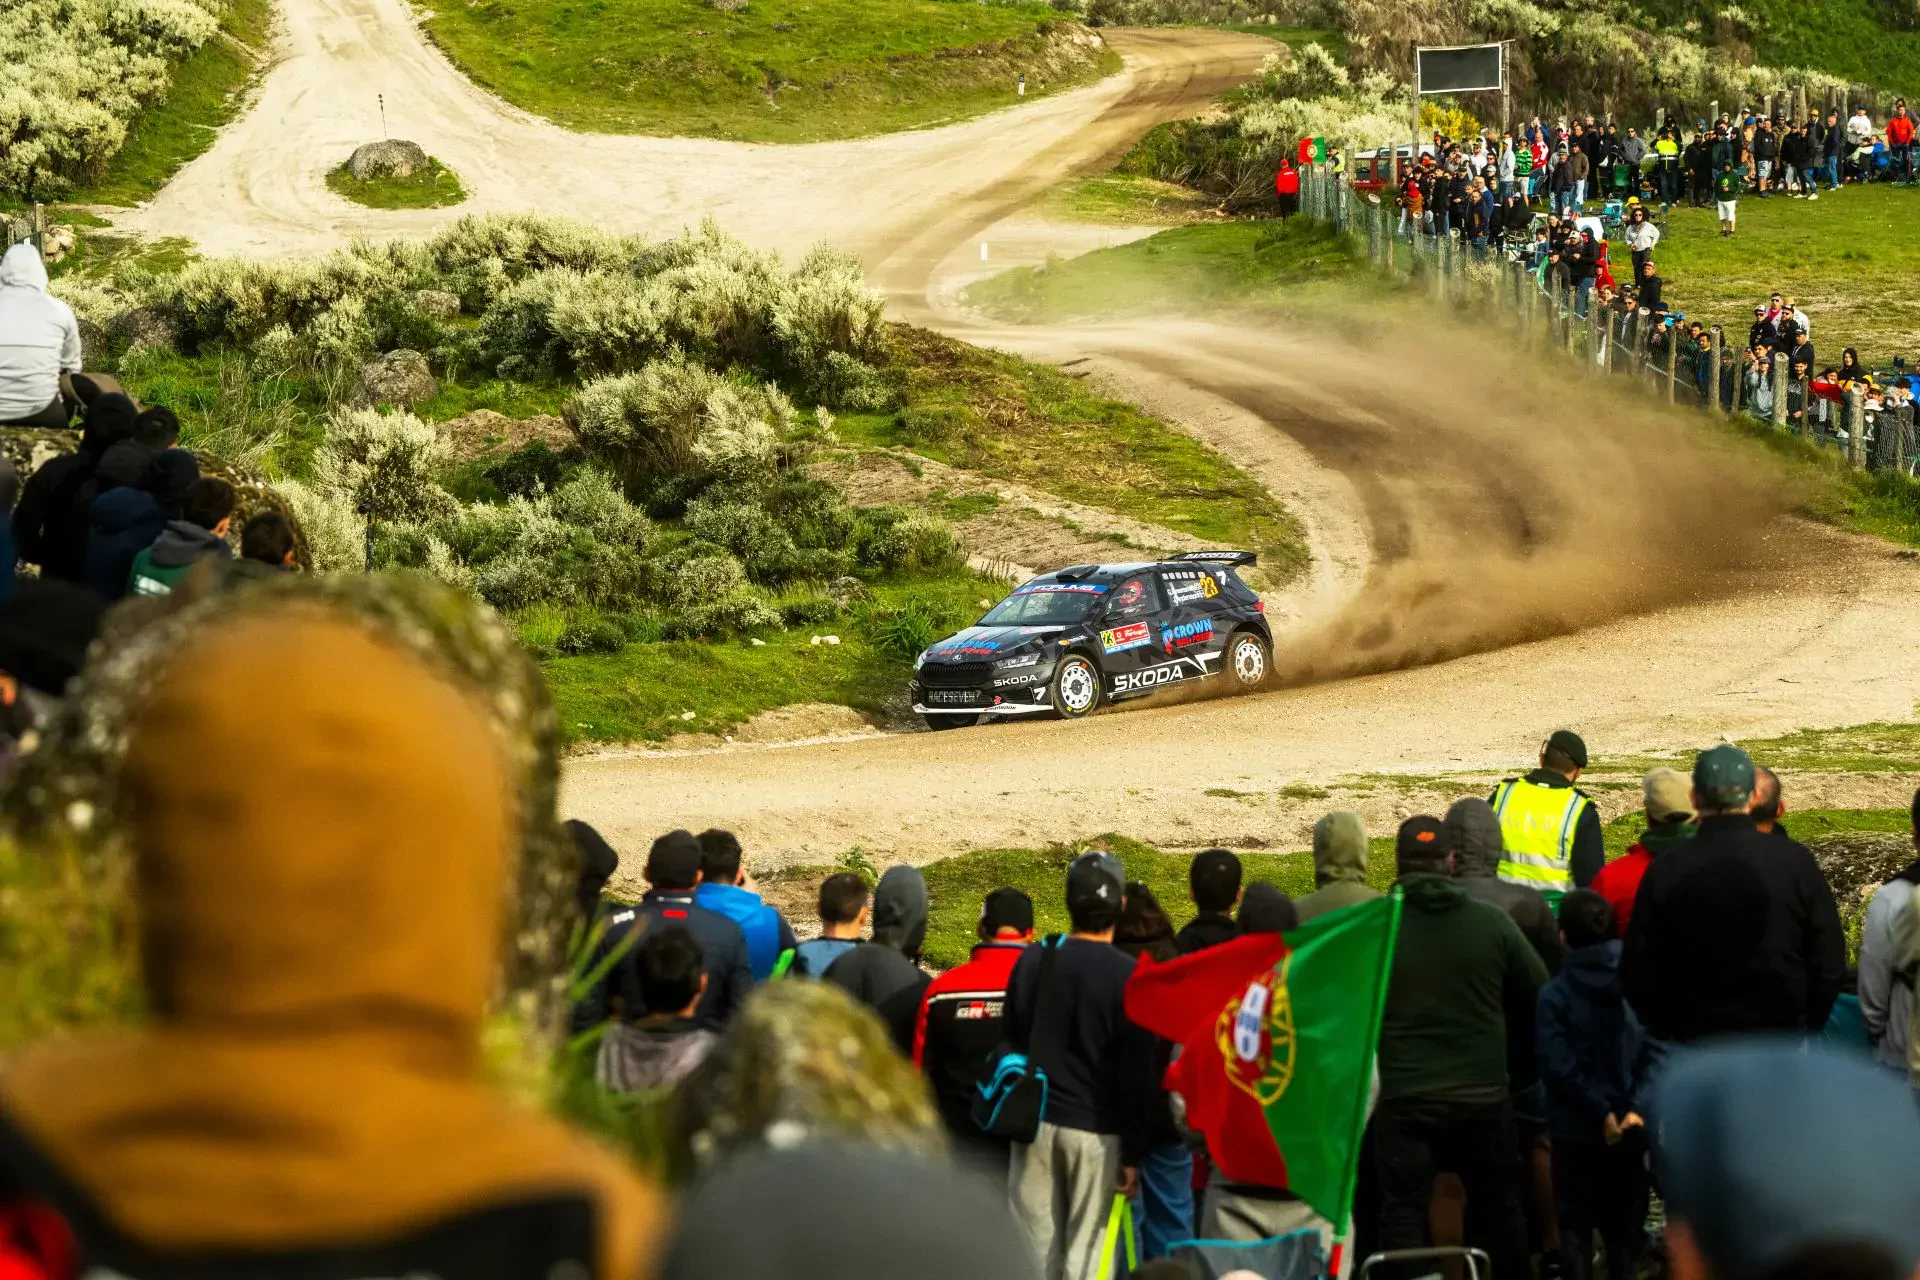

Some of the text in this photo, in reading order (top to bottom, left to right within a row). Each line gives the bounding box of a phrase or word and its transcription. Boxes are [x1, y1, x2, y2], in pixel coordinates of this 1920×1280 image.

[1199, 576, 1219, 598] 23
[1173, 618, 1213, 639] CROWN
[1101, 630, 1115, 647] 23
[1033, 686, 1047, 701] 7
